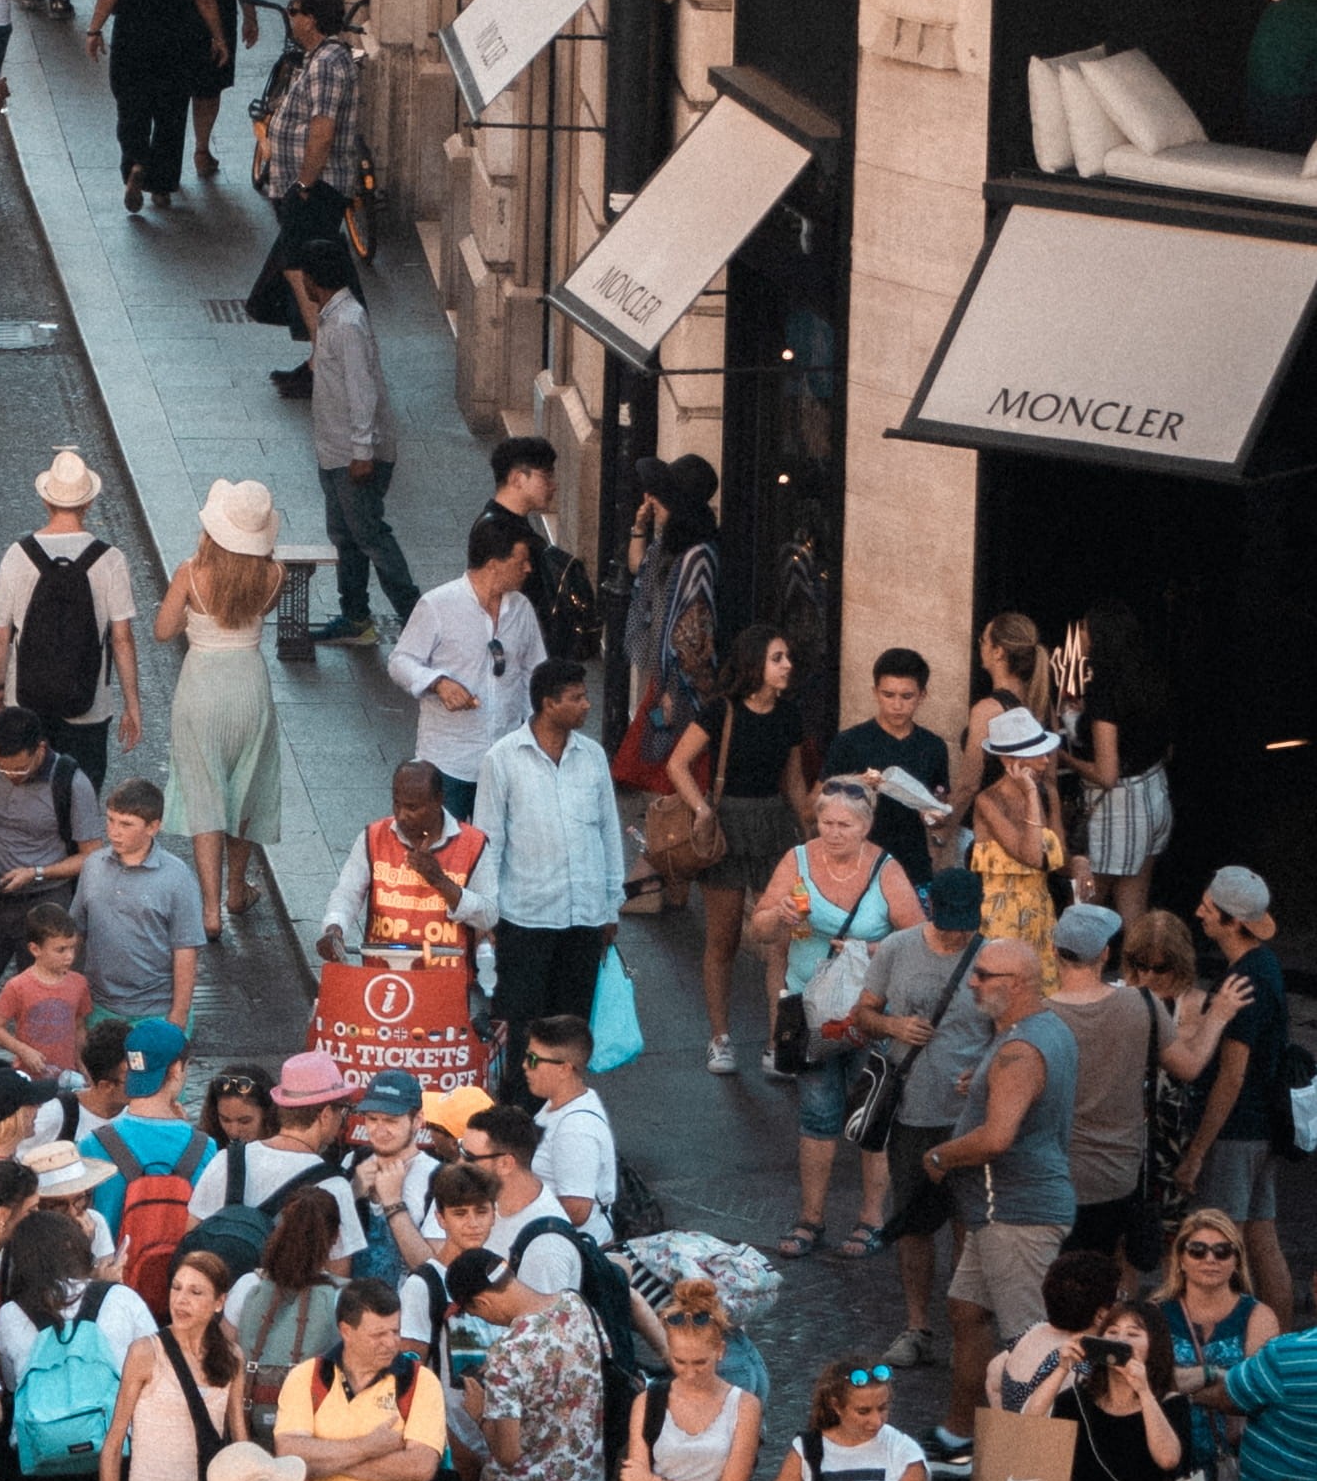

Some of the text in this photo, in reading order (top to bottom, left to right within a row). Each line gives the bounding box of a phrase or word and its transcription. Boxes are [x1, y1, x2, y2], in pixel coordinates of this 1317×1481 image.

[592, 264, 663, 327] MONCLER
[986, 387, 1185, 442] MONCLER
[372, 915, 408, 940] HOP
[424, 920, 458, 943] ON
[315, 1036, 471, 1069] ALL TICKETS
